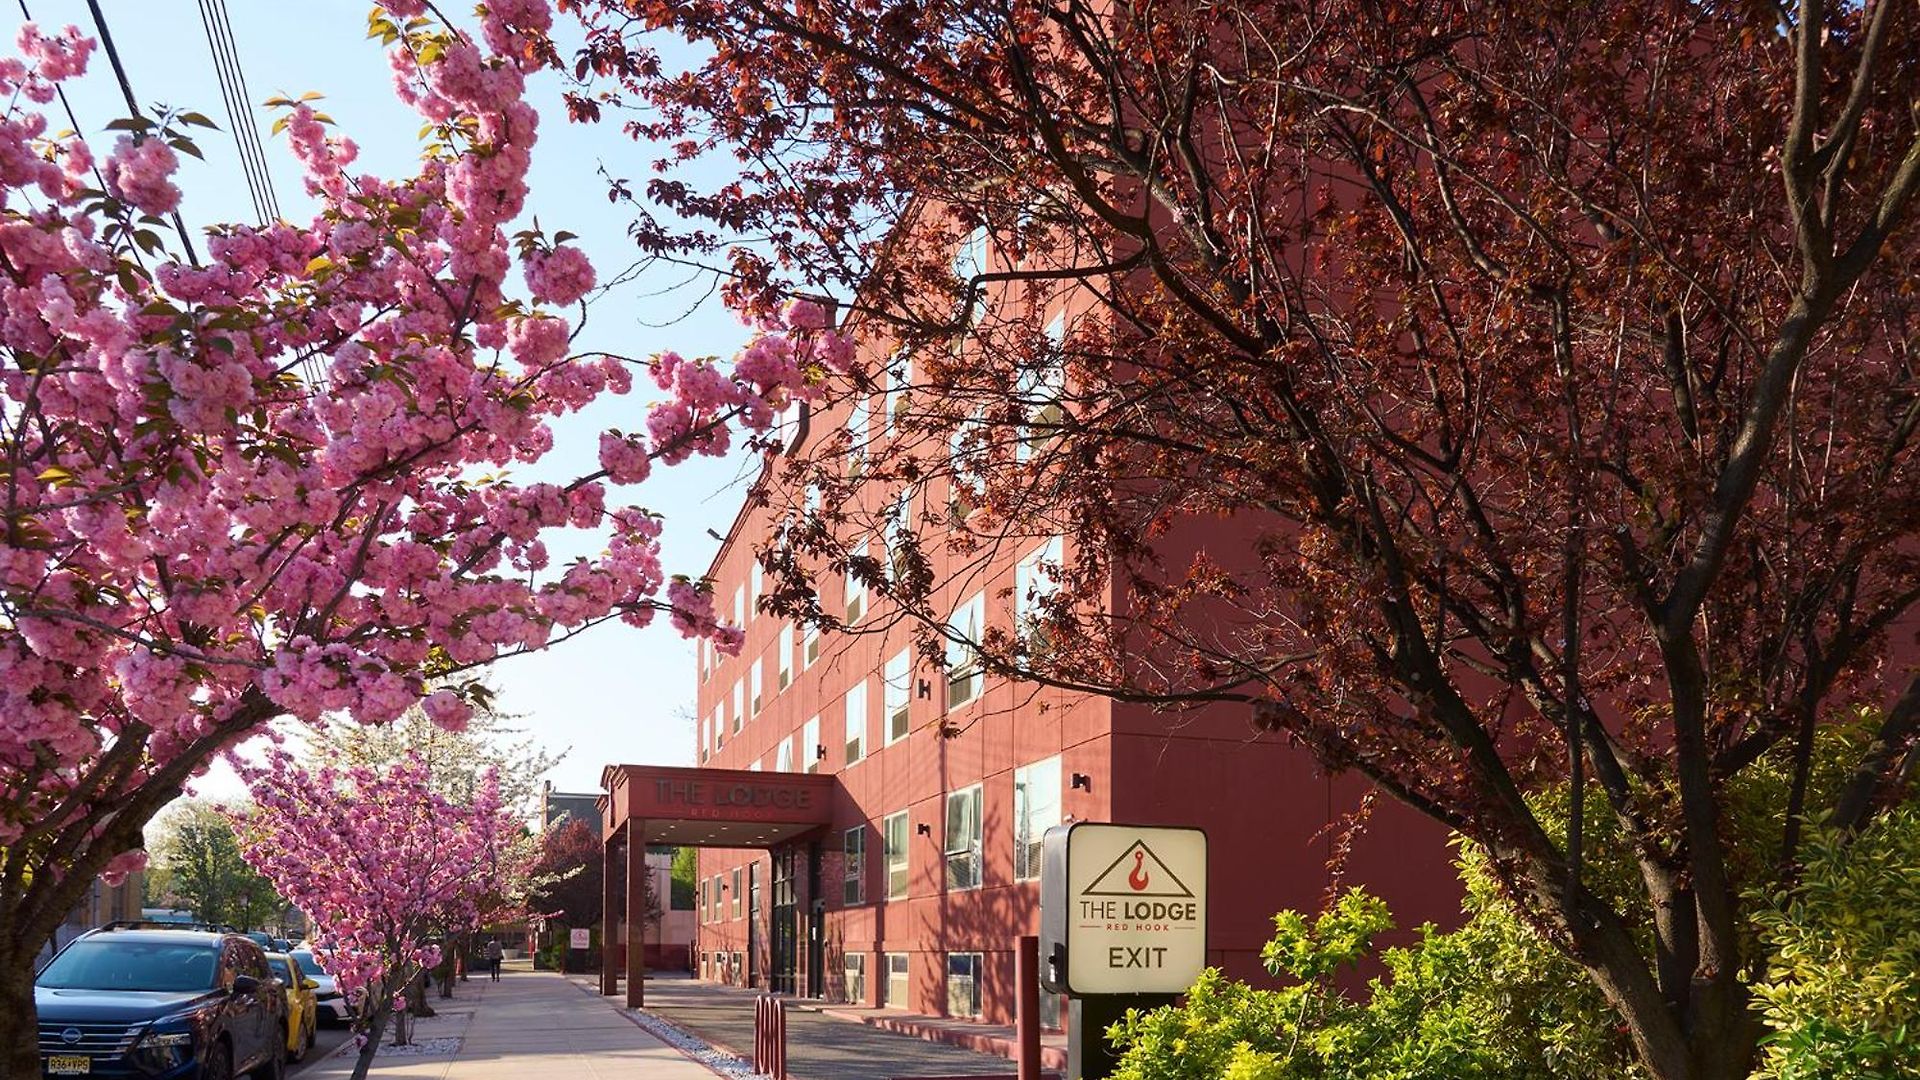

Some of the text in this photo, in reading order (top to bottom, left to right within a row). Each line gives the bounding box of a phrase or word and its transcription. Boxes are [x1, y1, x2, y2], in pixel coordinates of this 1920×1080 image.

[656, 778, 810, 809] THE LODGE
[1080, 901, 1196, 921] THE LODGE
[1106, 923, 1170, 932] RED HOOK
[1109, 947, 1168, 968] EXIT
